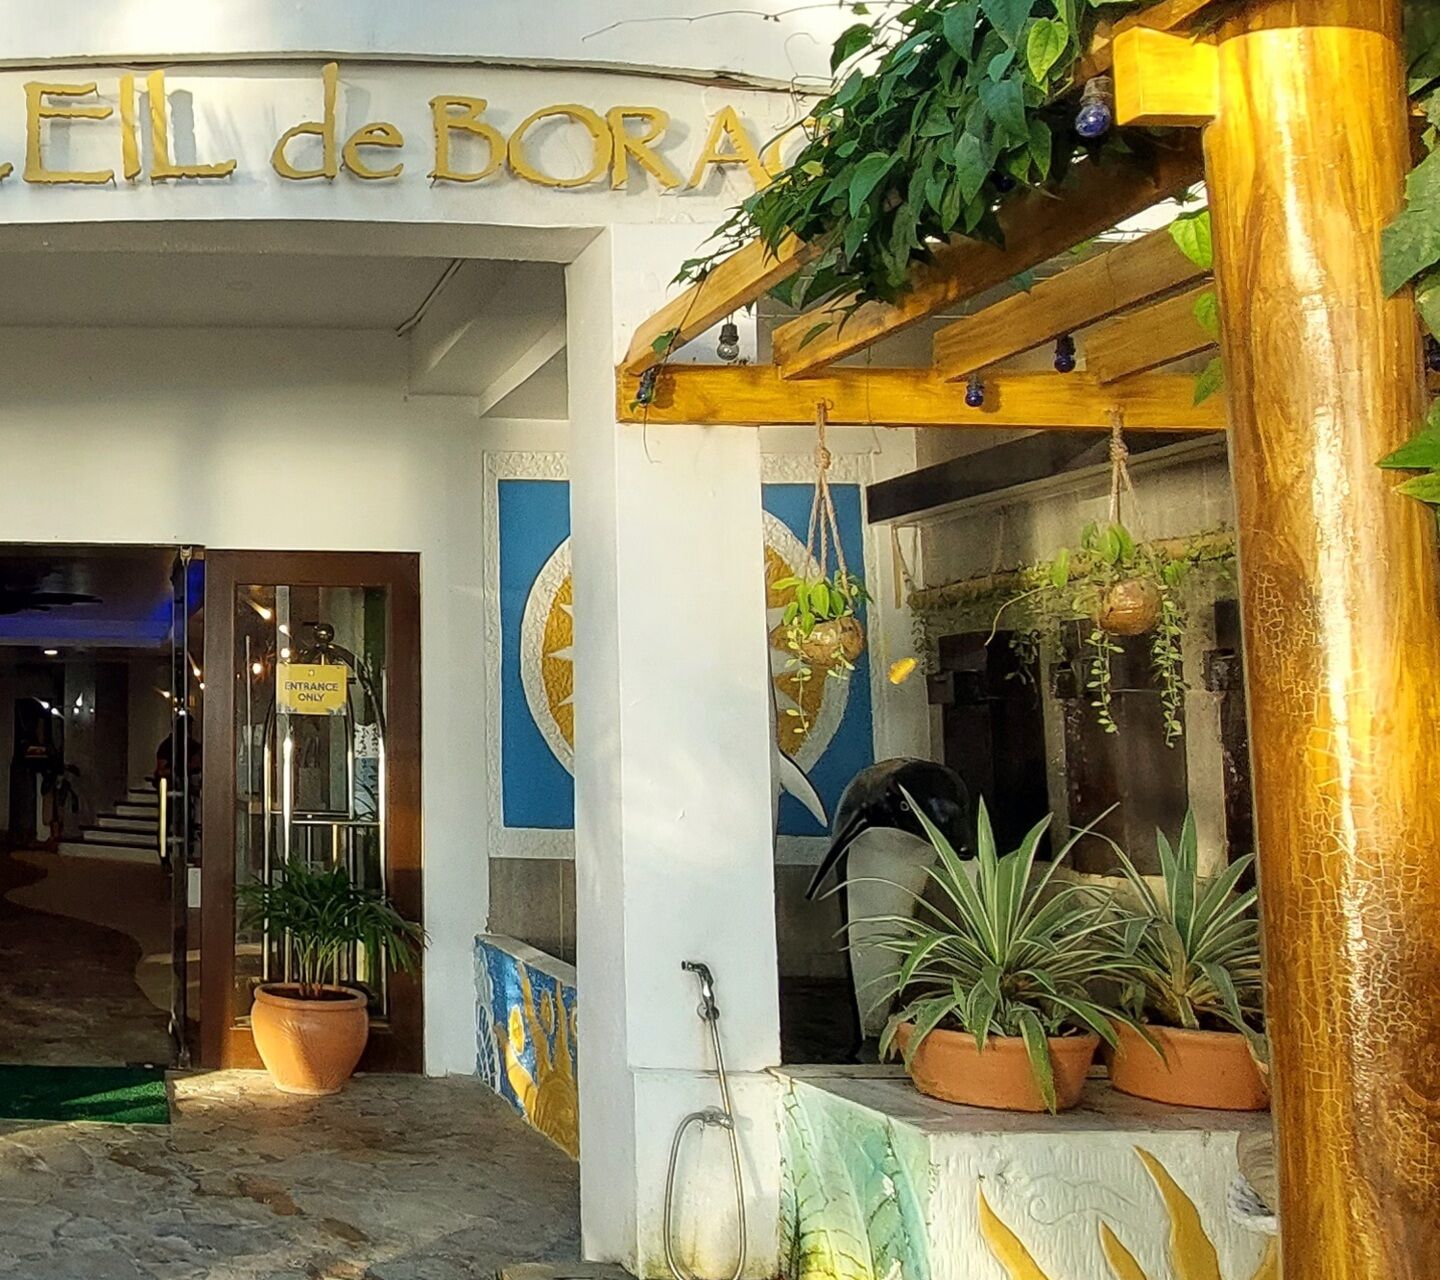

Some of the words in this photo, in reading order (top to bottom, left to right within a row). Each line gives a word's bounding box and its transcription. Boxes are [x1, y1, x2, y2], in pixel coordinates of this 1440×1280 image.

[270, 62, 404, 180] de
[285, 682, 339, 691] ENTRANCE
[297, 693, 325, 702] ONLY
